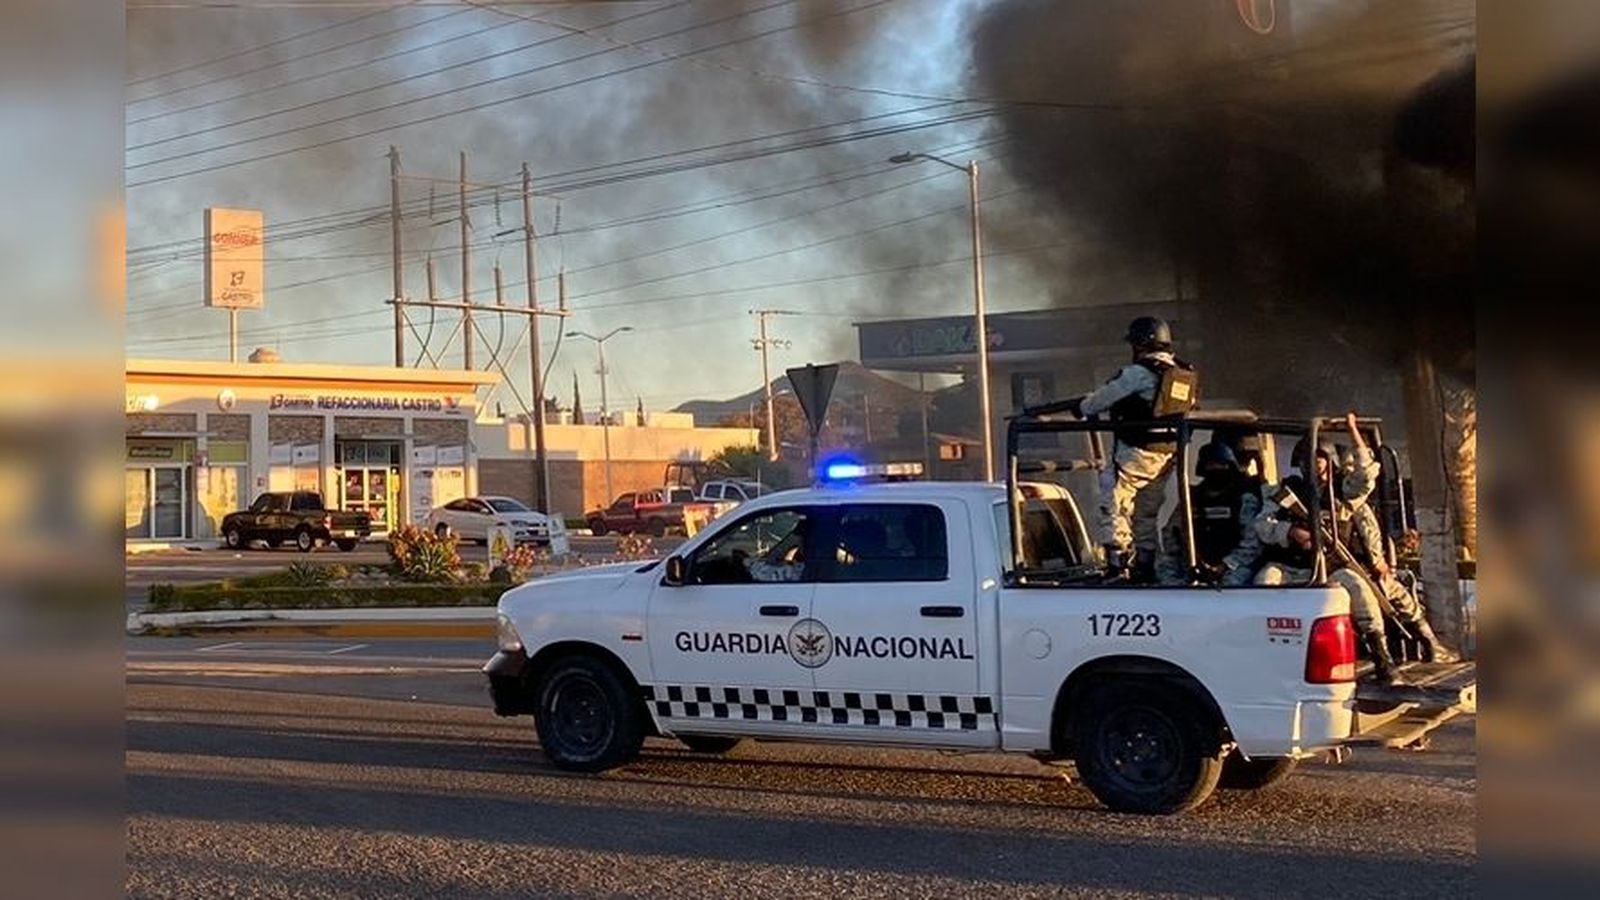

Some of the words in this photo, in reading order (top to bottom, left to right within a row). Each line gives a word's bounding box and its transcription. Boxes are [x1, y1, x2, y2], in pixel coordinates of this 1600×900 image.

[317, 395, 401, 411] REFACCIONARIA
[402, 397, 443, 412] CASTRO
[1086, 613, 1162, 637] 17223
[675, 632, 788, 656] GUARDIA
[834, 635, 974, 660] NACIONAL
